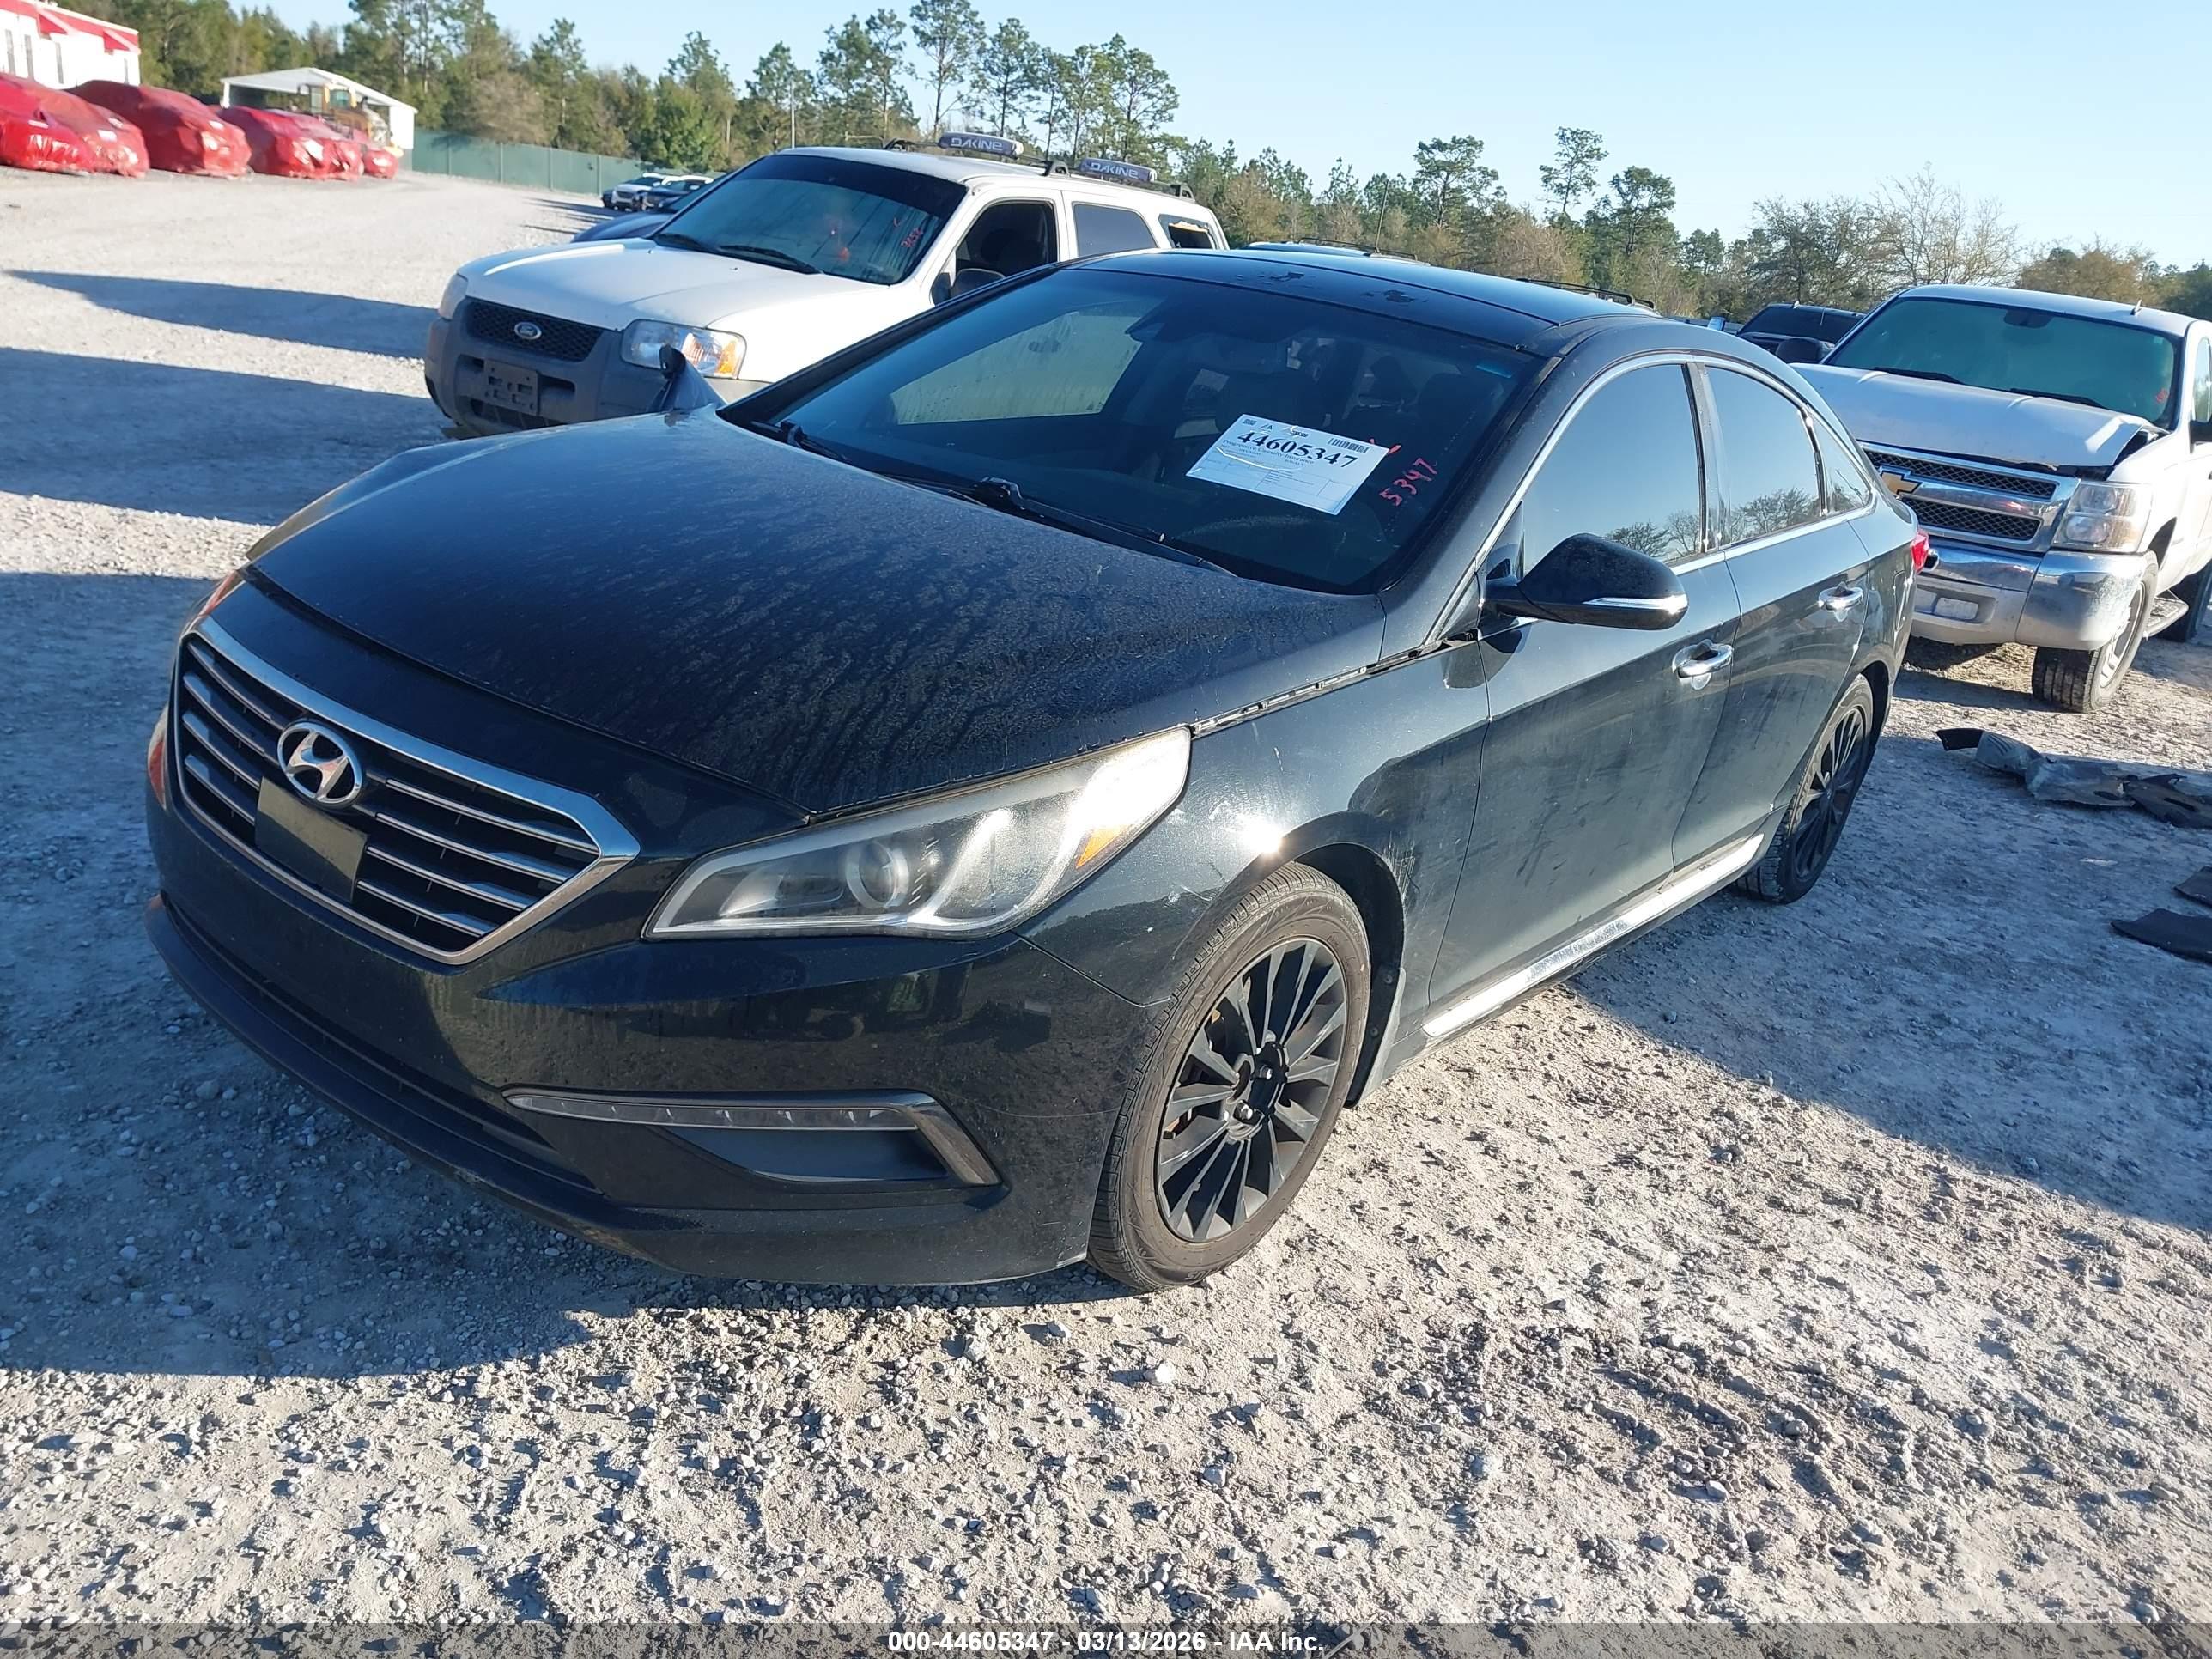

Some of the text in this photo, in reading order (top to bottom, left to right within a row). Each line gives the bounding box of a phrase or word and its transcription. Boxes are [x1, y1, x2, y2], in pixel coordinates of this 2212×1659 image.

[951, 137, 1003, 150] DAKINE
[1090, 162, 1139, 179] DAKINE
[1237, 432, 1358, 467] 44605347
[1379, 458, 1437, 506] 5347
